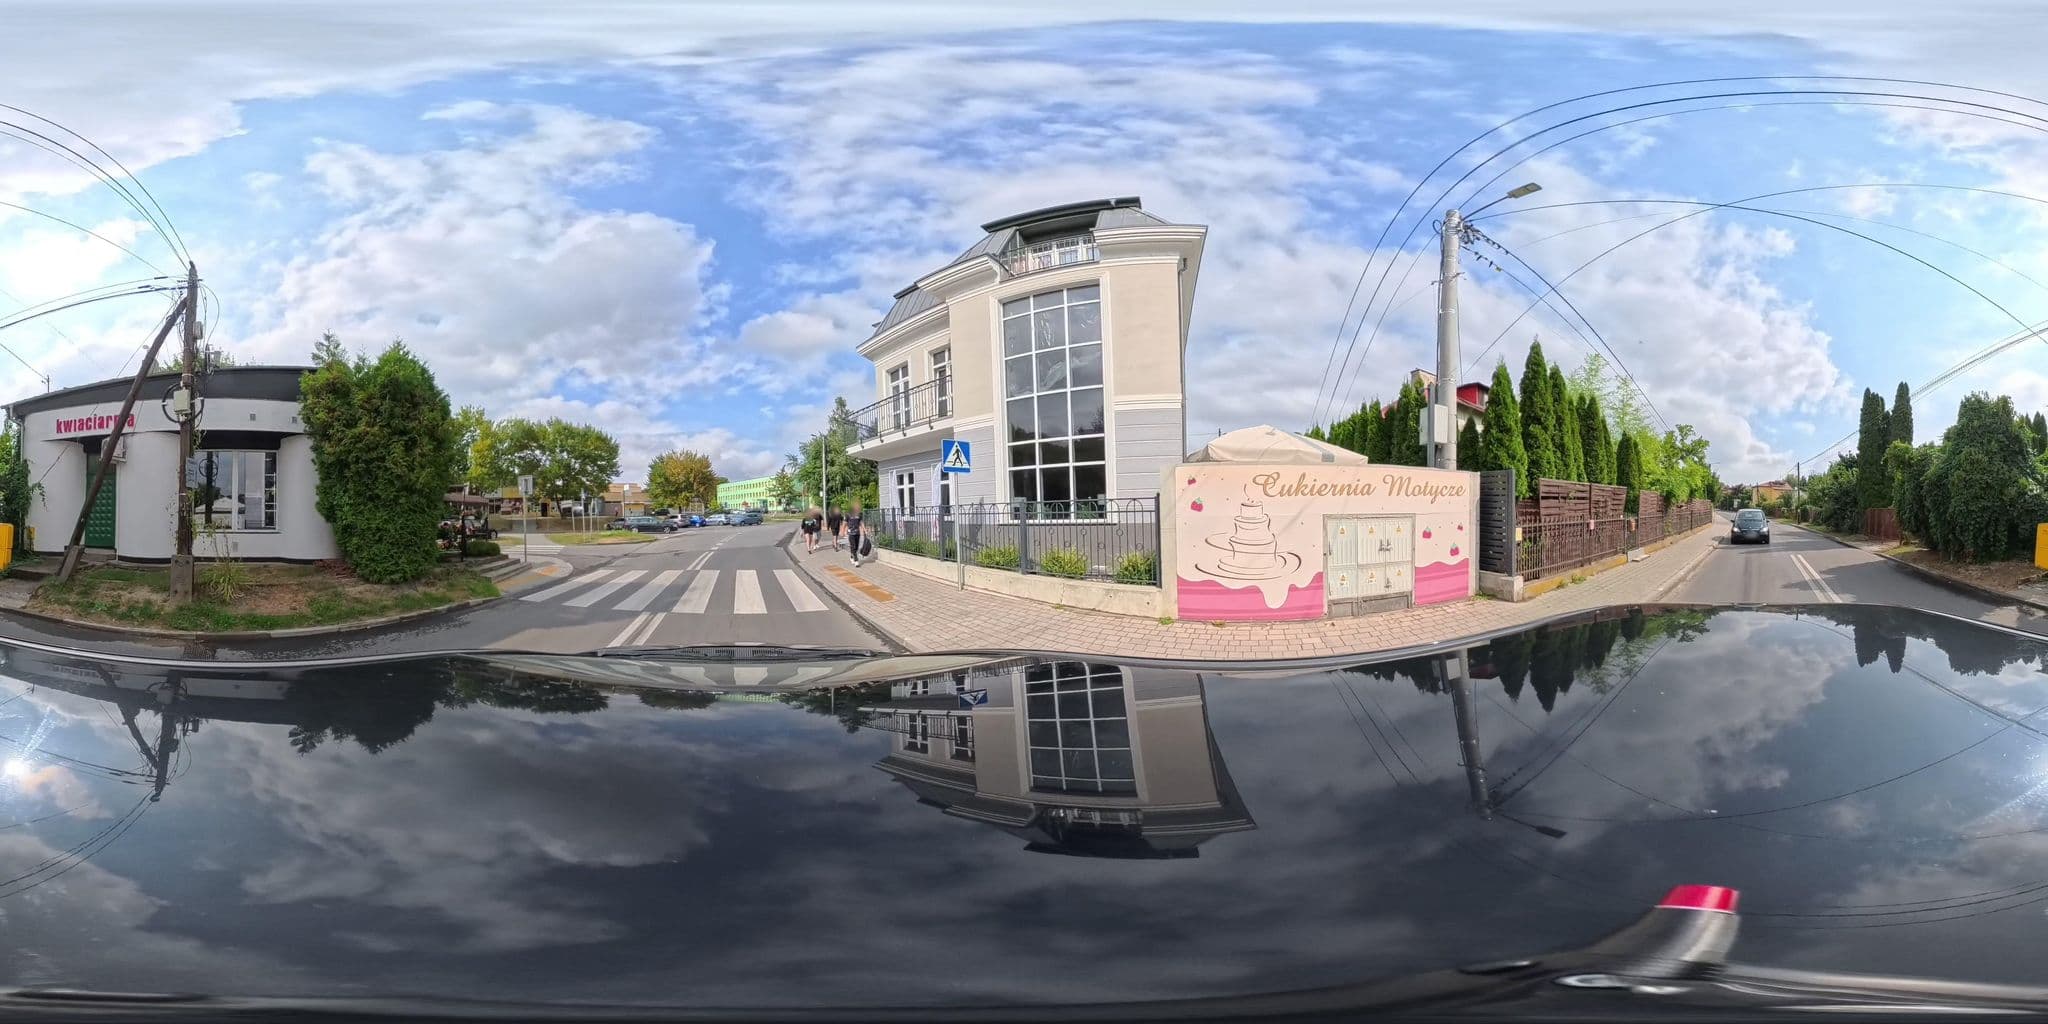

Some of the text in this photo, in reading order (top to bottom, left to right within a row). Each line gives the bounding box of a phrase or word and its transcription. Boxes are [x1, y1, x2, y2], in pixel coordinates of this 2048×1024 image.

[56, 413, 135, 434] kwiaciarna
[1252, 471, 1466, 505] Cukiernia Motycze
